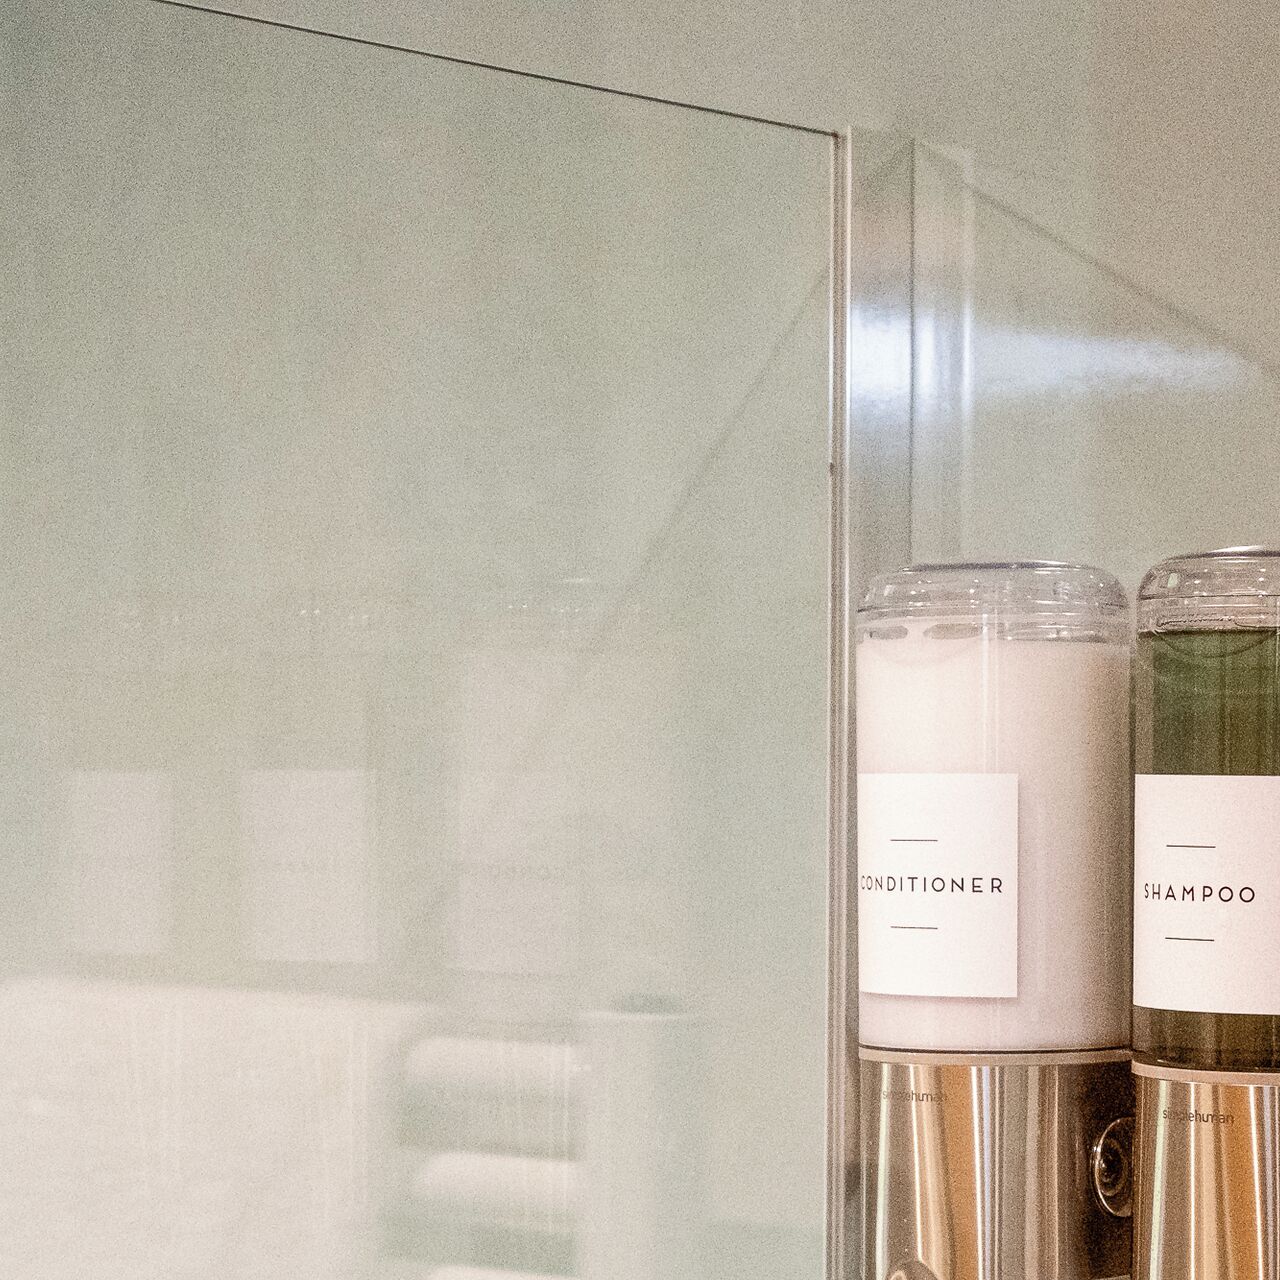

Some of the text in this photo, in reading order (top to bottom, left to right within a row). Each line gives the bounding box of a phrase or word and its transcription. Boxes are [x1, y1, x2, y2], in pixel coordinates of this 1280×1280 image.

[860, 875, 1003, 893] CONDITIONER
[1144, 882, 1256, 903] SHAMPOO
[882, 1089, 947, 1103] sehuman
